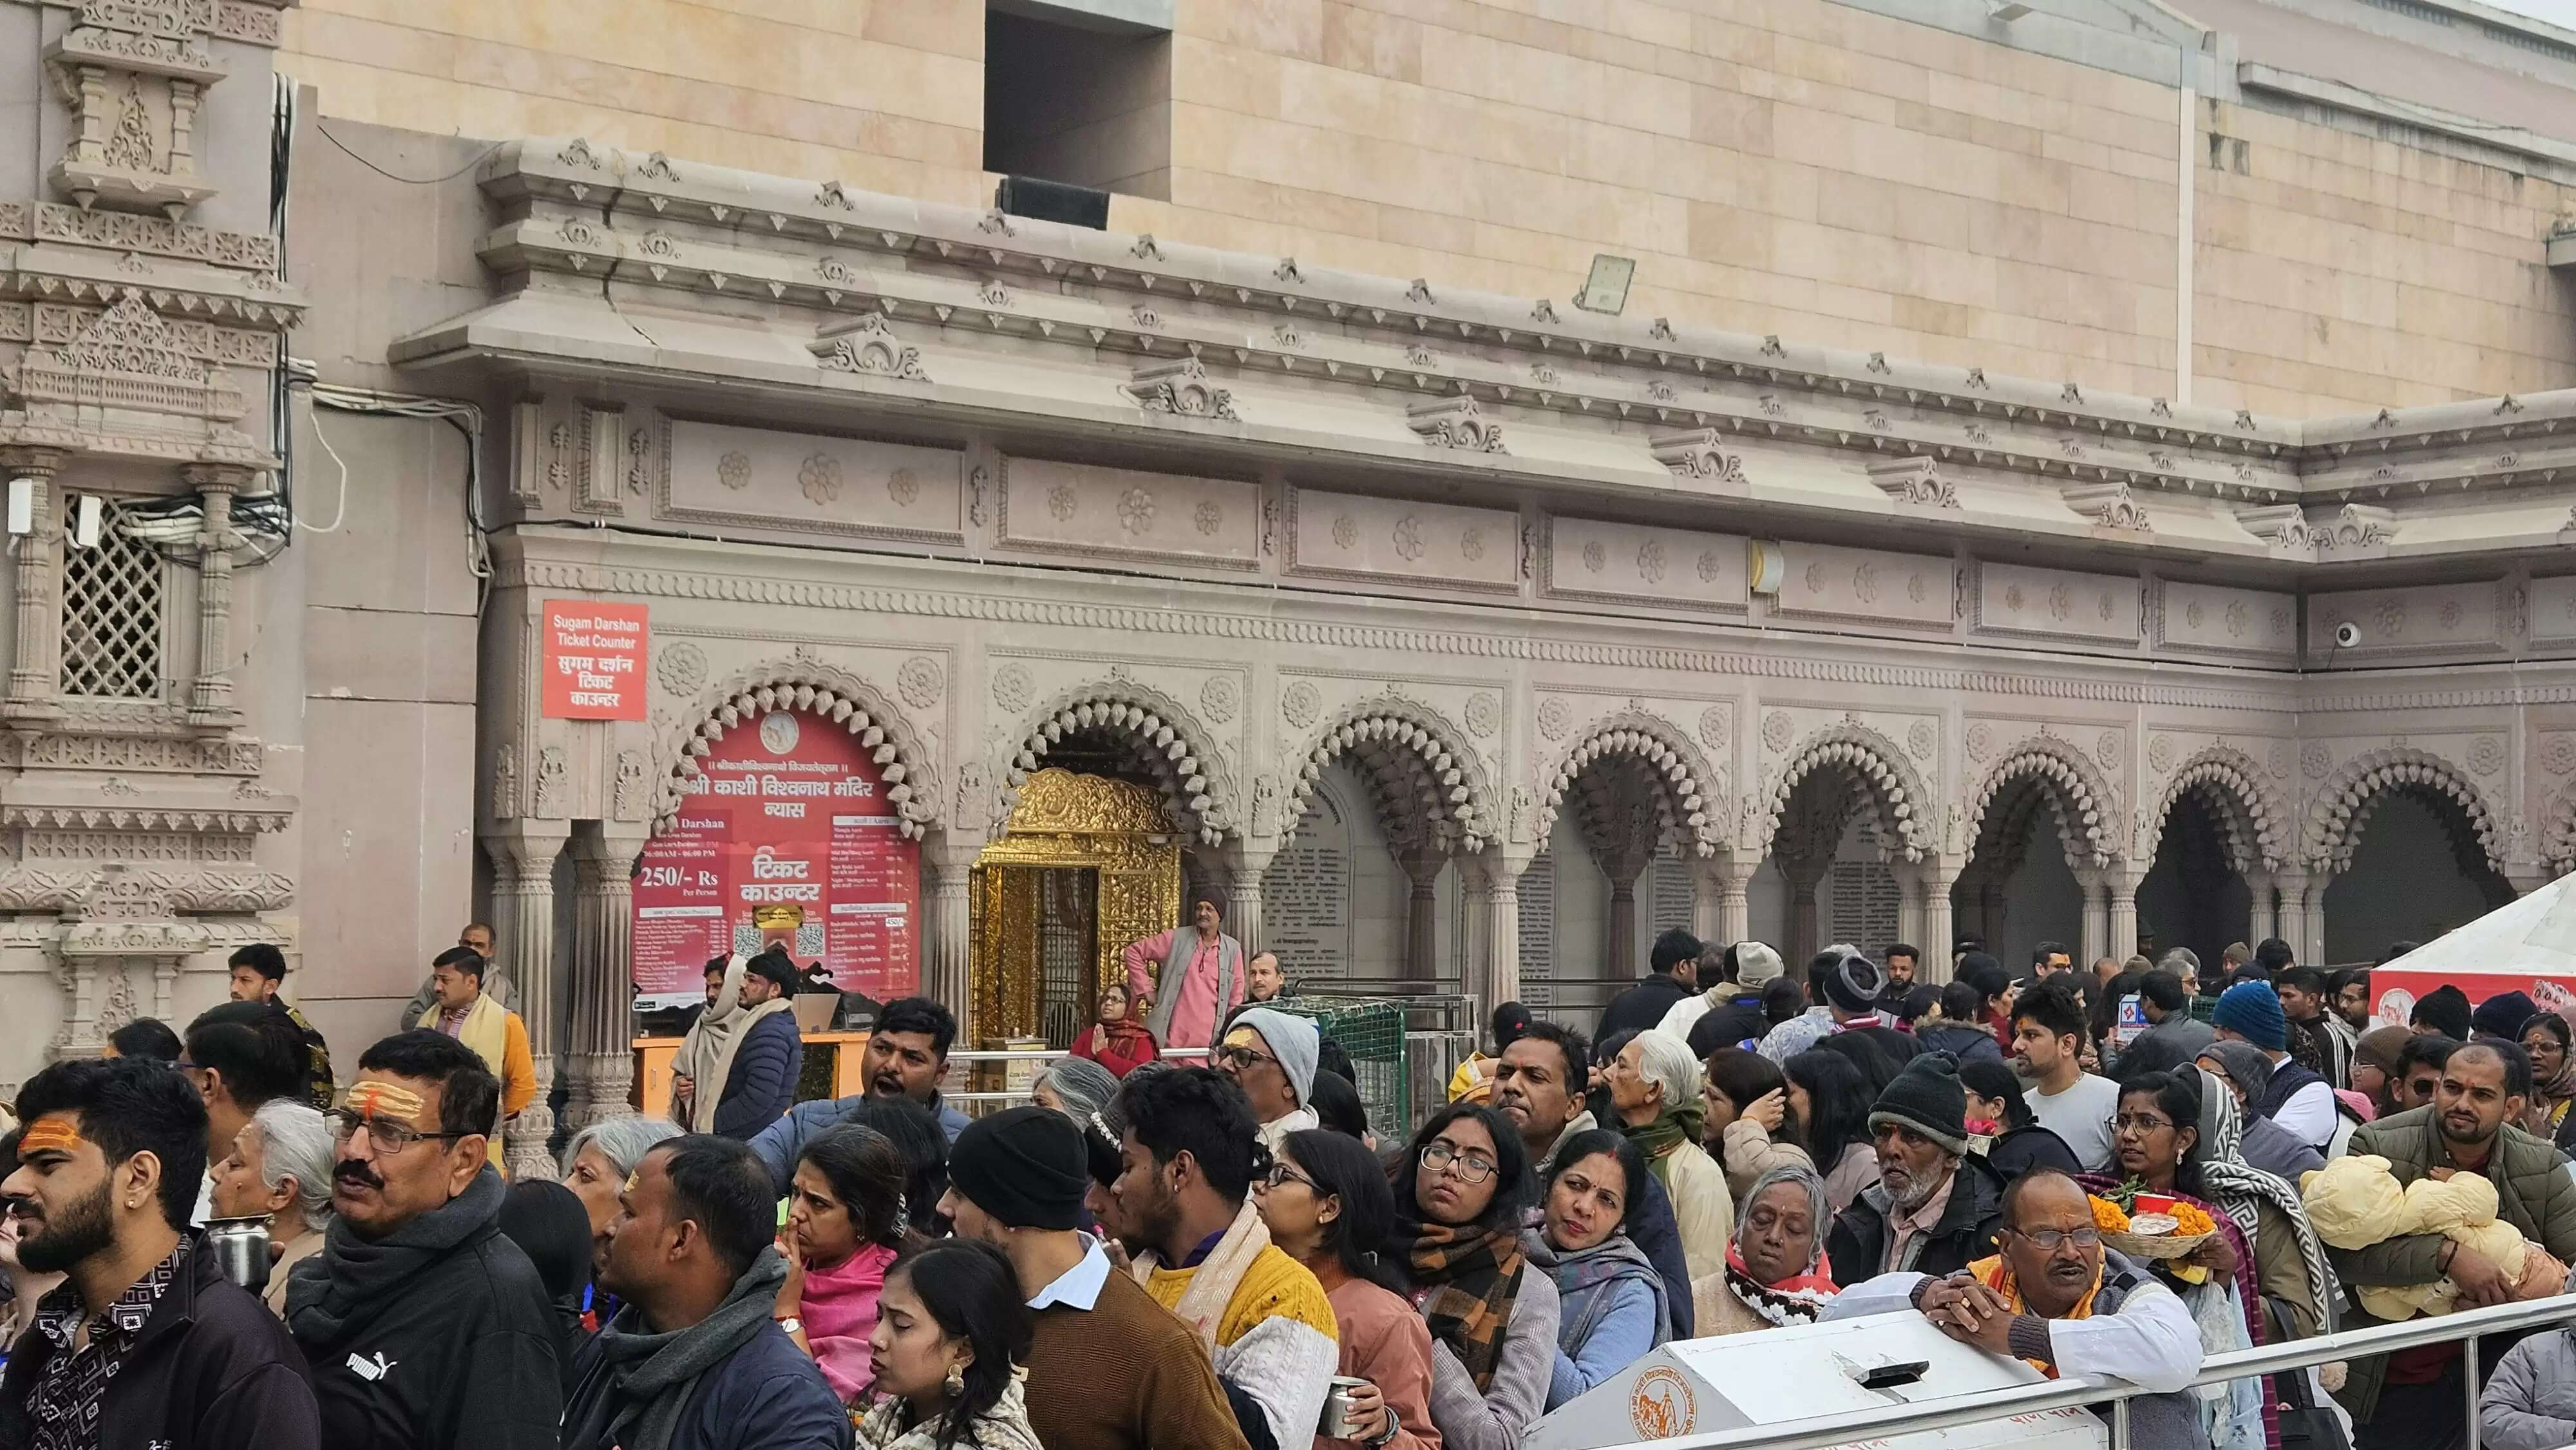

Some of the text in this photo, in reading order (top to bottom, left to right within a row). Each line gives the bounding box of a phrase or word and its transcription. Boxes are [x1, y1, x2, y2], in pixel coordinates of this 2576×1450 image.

[553, 614, 639, 632] Sugam Darshan
[557, 632, 636, 649] Ticket Counter
[557, 655, 634, 674] सुगम दर्शन
[578, 671, 614, 689] टिकट
[570, 691, 621, 707] काउन्टर
[714, 774, 758, 795] काशी
[761, 775, 830, 796] विश्वनाथ
[833, 776, 875, 796] मंदिर
[764, 802, 806, 818] न्यास
[681, 818, 724, 829] Darshan
[752, 854, 809, 878] टिकट
[641, 867, 718, 887] 250/- Rs
[740, 883, 822, 901] काउन्टर
